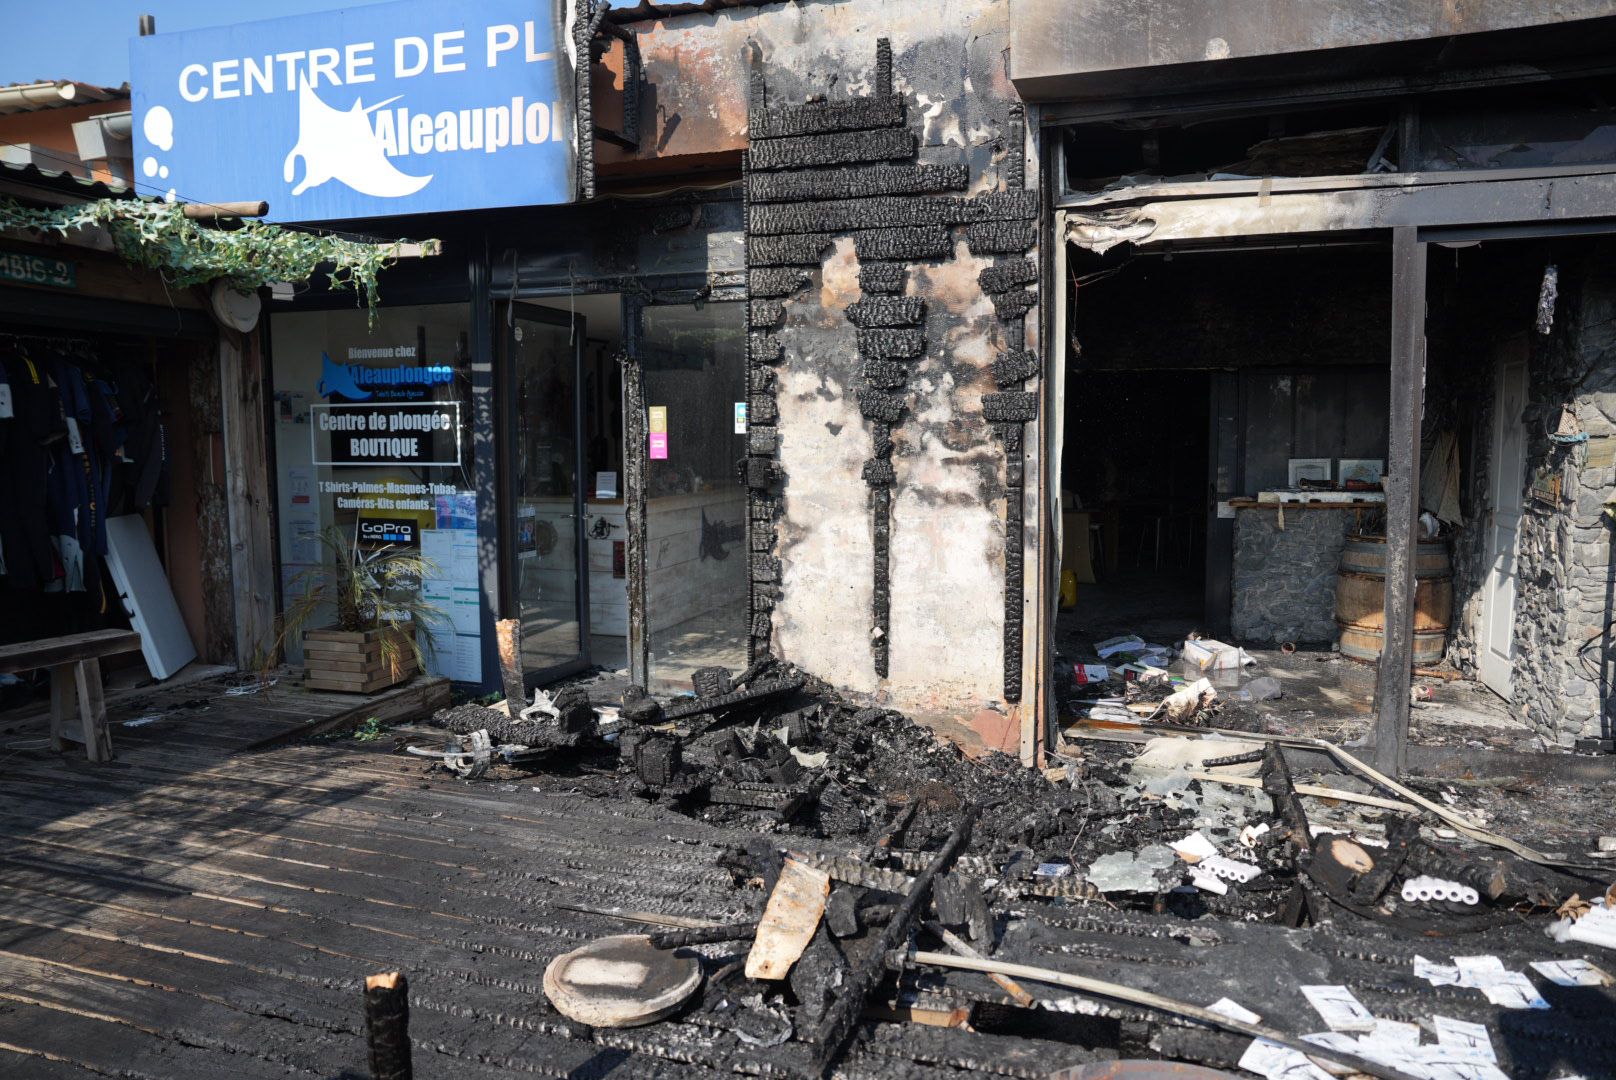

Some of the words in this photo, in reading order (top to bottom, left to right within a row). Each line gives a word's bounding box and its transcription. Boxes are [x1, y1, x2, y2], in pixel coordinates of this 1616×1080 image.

[179, 41, 376, 103] CENTRE
[394, 30, 467, 78] DE
[348, 347, 394, 359] Bienvenue
[395, 345, 416, 358] chez
[351, 362, 453, 385] Aleauplongée
[319, 412, 366, 431] Centre
[368, 411, 387, 430] de
[389, 410, 451, 432] plongée
[350, 438, 418, 458] BOUTIQUE
[396, 497, 430, 511] enfants
[361, 522, 412, 534] GoPro
